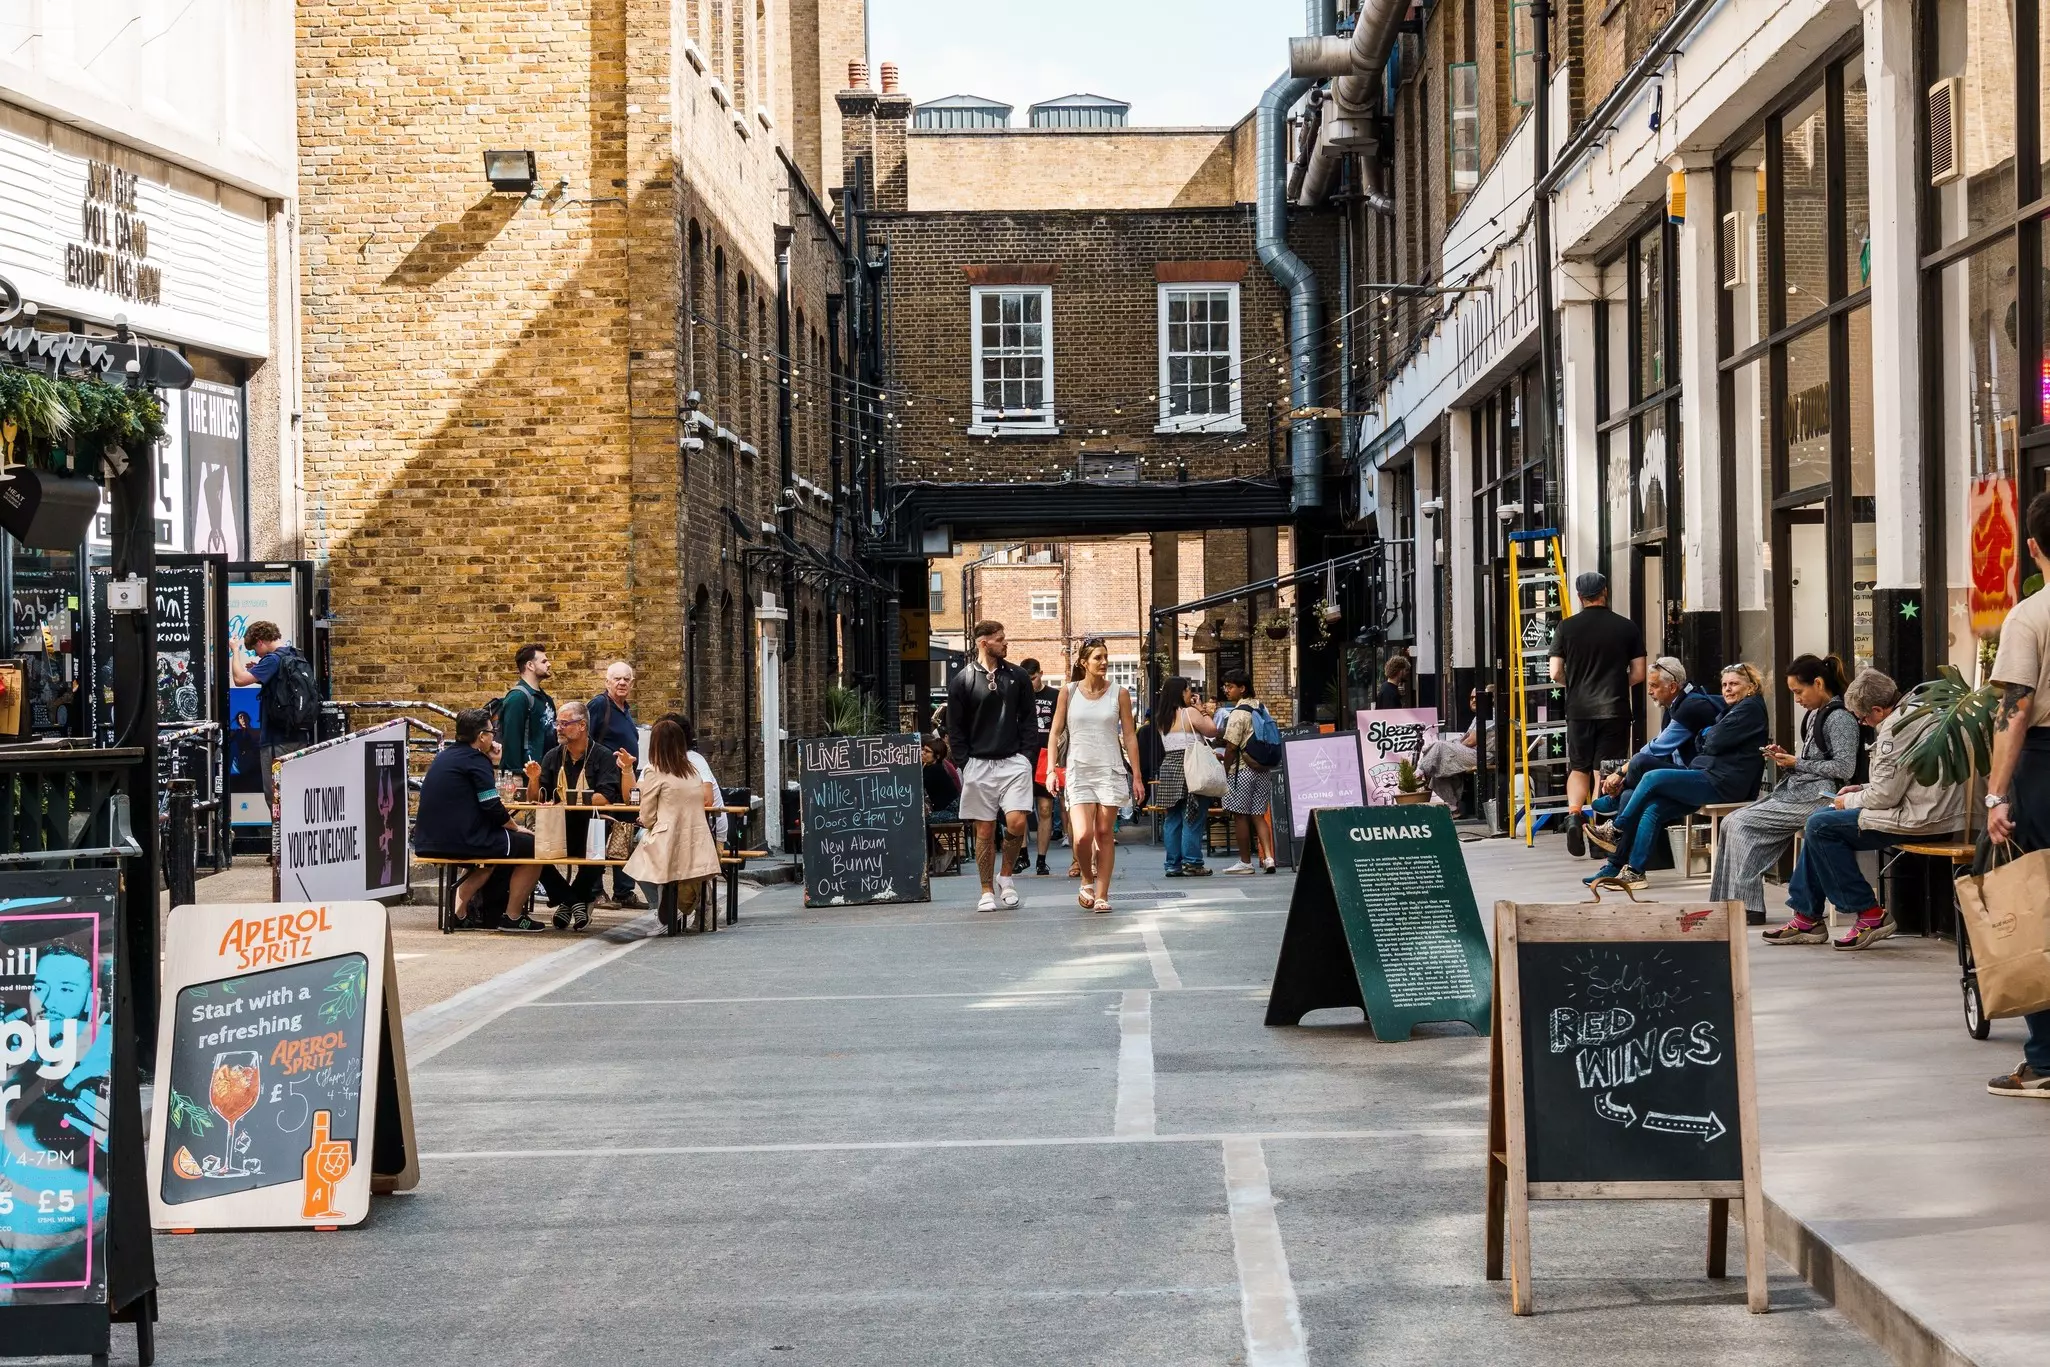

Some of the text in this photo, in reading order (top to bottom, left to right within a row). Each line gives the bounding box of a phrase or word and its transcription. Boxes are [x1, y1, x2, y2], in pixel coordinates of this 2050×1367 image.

[188, 390, 240, 440] THE HIVES
[7, 486, 26, 502] HEAT
[157, 633, 190, 642] KNOW
[1377, 738, 1416, 759] Pizz
[304, 786, 345, 824] OUT NOW!!
[814, 776, 913, 812] Willie J Healey
[1298, 792, 1334, 800] LOADING
[814, 815, 848, 830] Doors
[852, 812, 862, 826] @
[1350, 824, 1432, 842] CUEMARS
[288, 826, 360, 869] YOU'RE WELCOME.
[821, 836, 886, 854] New Album
[832, 852, 884, 878] Bunny
[818, 876, 893, 895] Out Now
[218, 906, 332, 956] APEROL
[192, 986, 311, 1023] Start with a
[198, 1014, 302, 1048] refreshing
[1550, 1007, 1635, 1053] RED
[270, 1030, 347, 1066] APEROL
[1576, 1020, 1722, 1089] WINGS
[16, 1150, 74, 1165] 4-7PM
[38, 1189, 74, 1213] £5
